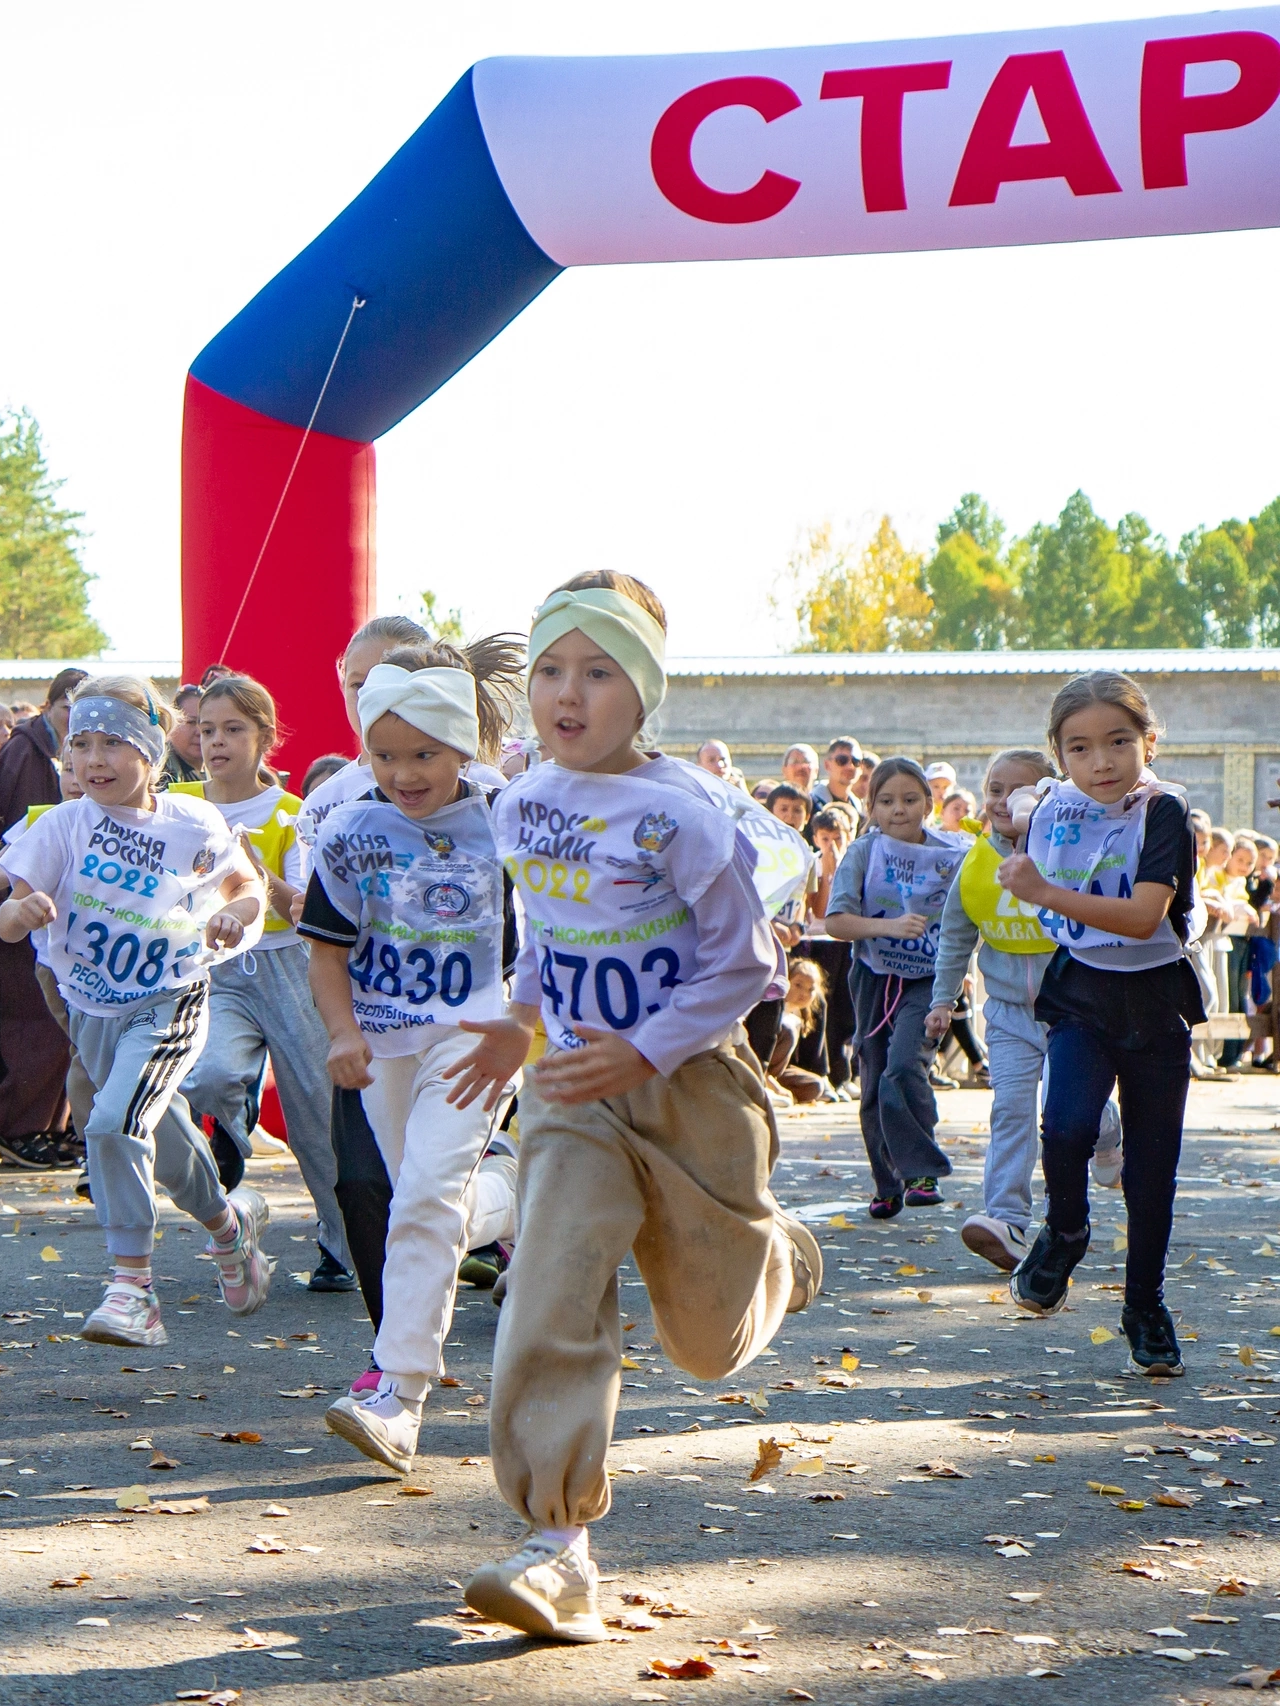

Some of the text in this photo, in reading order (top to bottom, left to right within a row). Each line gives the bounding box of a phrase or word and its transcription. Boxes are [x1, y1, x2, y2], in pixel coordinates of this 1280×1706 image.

[650, 30, 1280, 225] СТАР
[79, 853, 159, 899] 2022
[73, 891, 108, 913] ПОРТ
[114, 907, 161, 930] НОРМА
[554, 925, 621, 946] НОРМА
[624, 907, 689, 943] ЖИЗНИ
[348, 936, 473, 1007] 4830
[541, 944, 684, 1030] 4703
